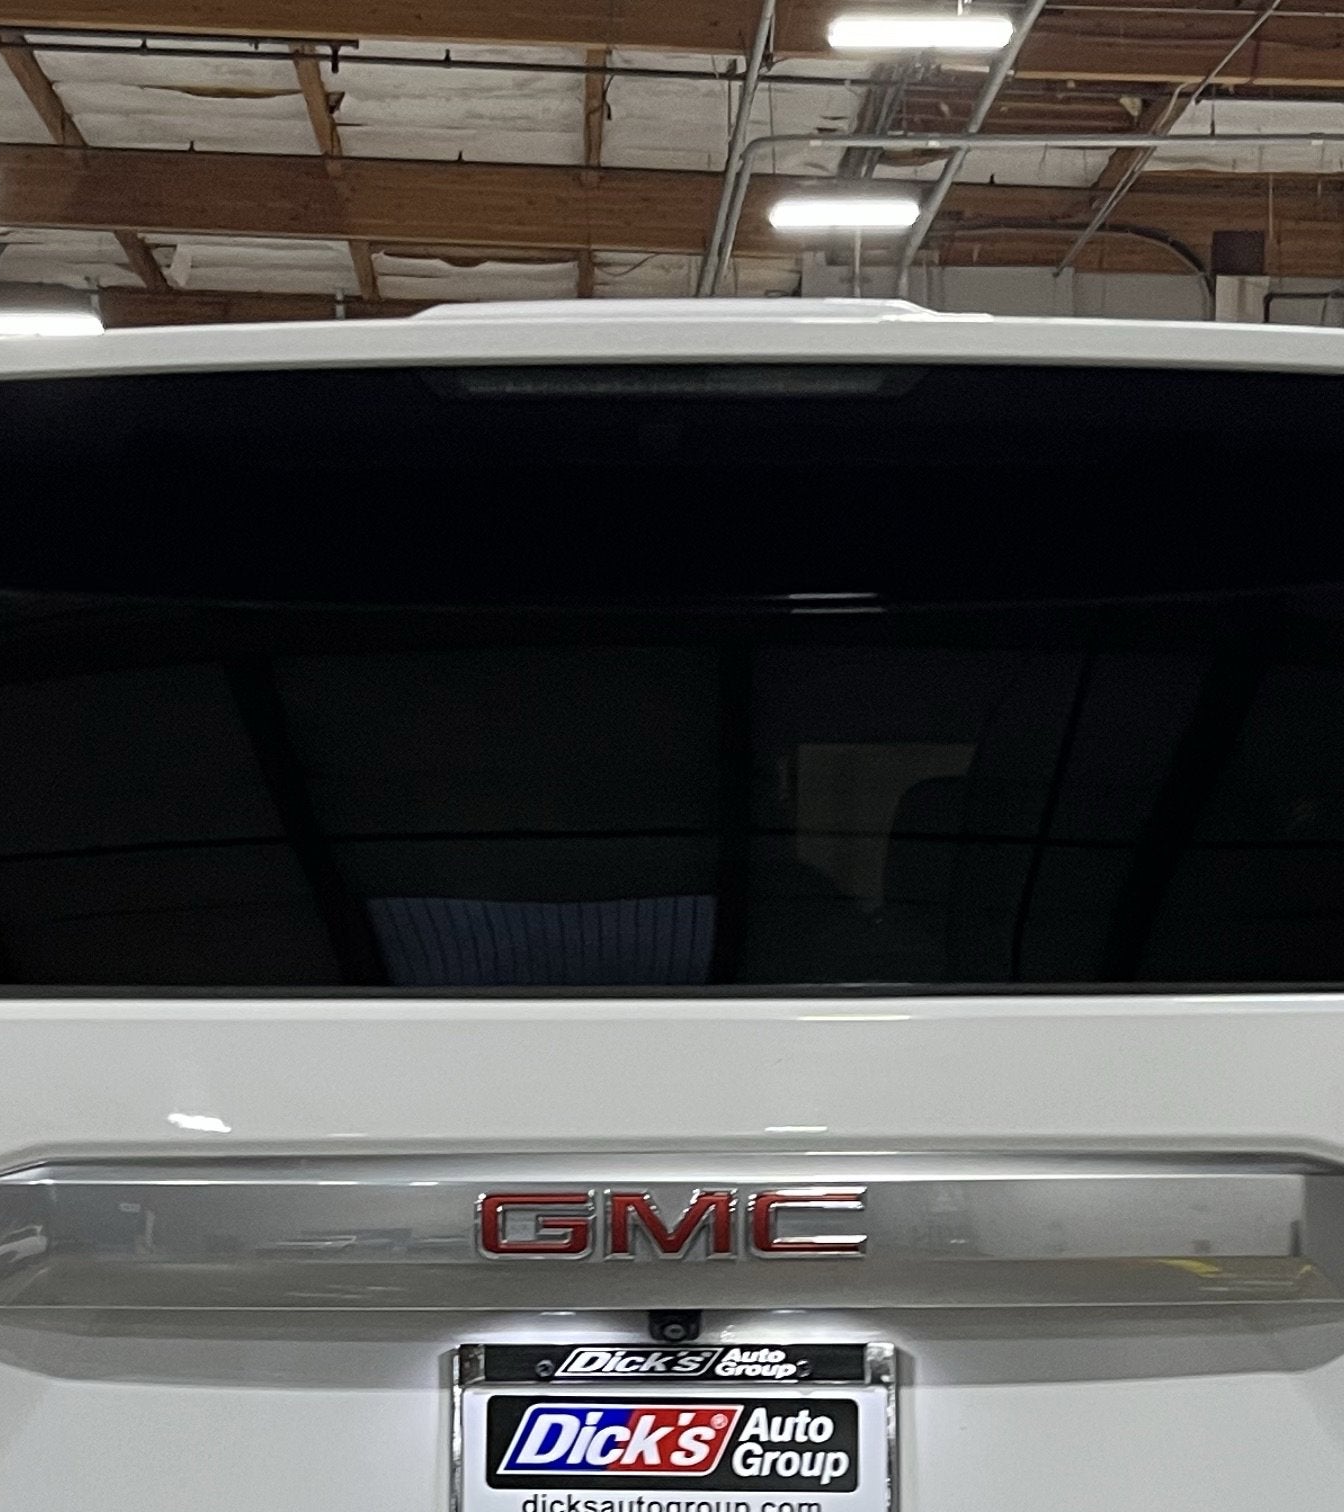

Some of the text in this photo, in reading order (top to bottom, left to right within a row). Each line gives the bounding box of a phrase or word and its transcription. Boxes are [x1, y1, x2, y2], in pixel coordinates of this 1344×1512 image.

[477, 1186, 867, 1260] GMC
[567, 1350, 706, 1373] Dick's
[714, 1361, 797, 1379] Group
[721, 1348, 786, 1363] Auto
[515, 1411, 717, 1467] Dick's
[738, 1407, 834, 1443] Auto
[731, 1442, 850, 1485] Group
